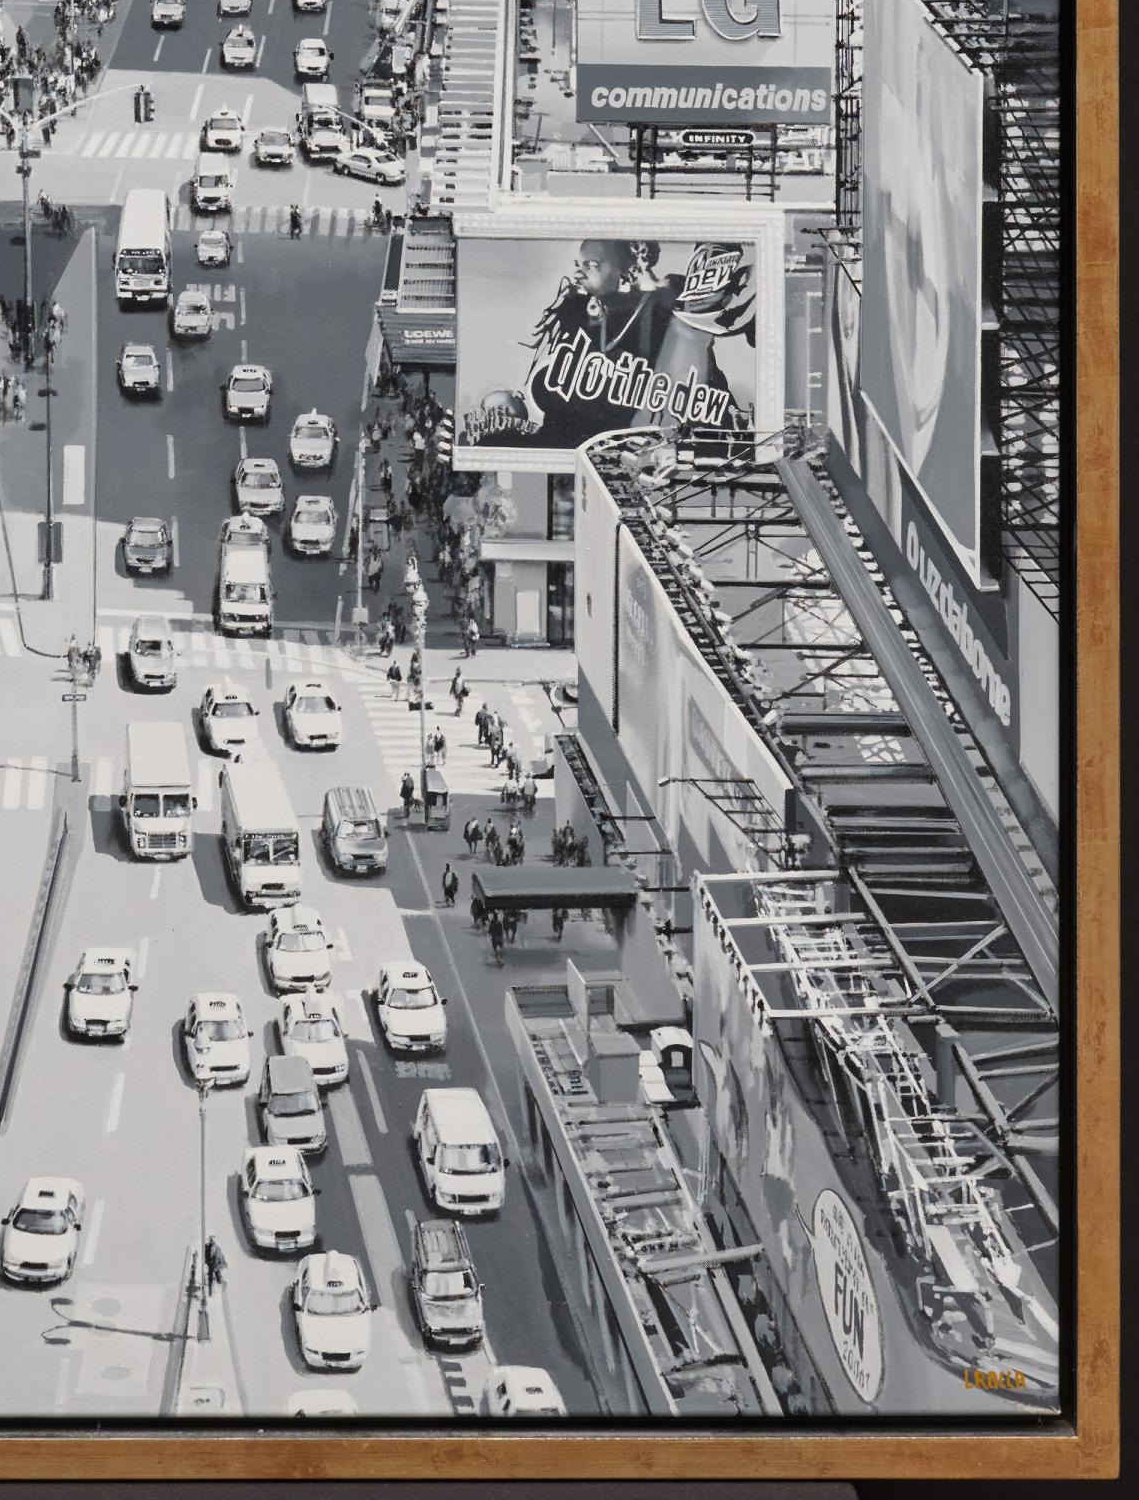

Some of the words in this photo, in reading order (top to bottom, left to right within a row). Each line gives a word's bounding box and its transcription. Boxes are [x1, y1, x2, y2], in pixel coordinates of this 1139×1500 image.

[590, 82, 828, 112] communications
[689, 134, 747, 144] INFINITY
[404, 329, 454, 338] LOEWE
[835, 1261, 864, 1361] FUN
